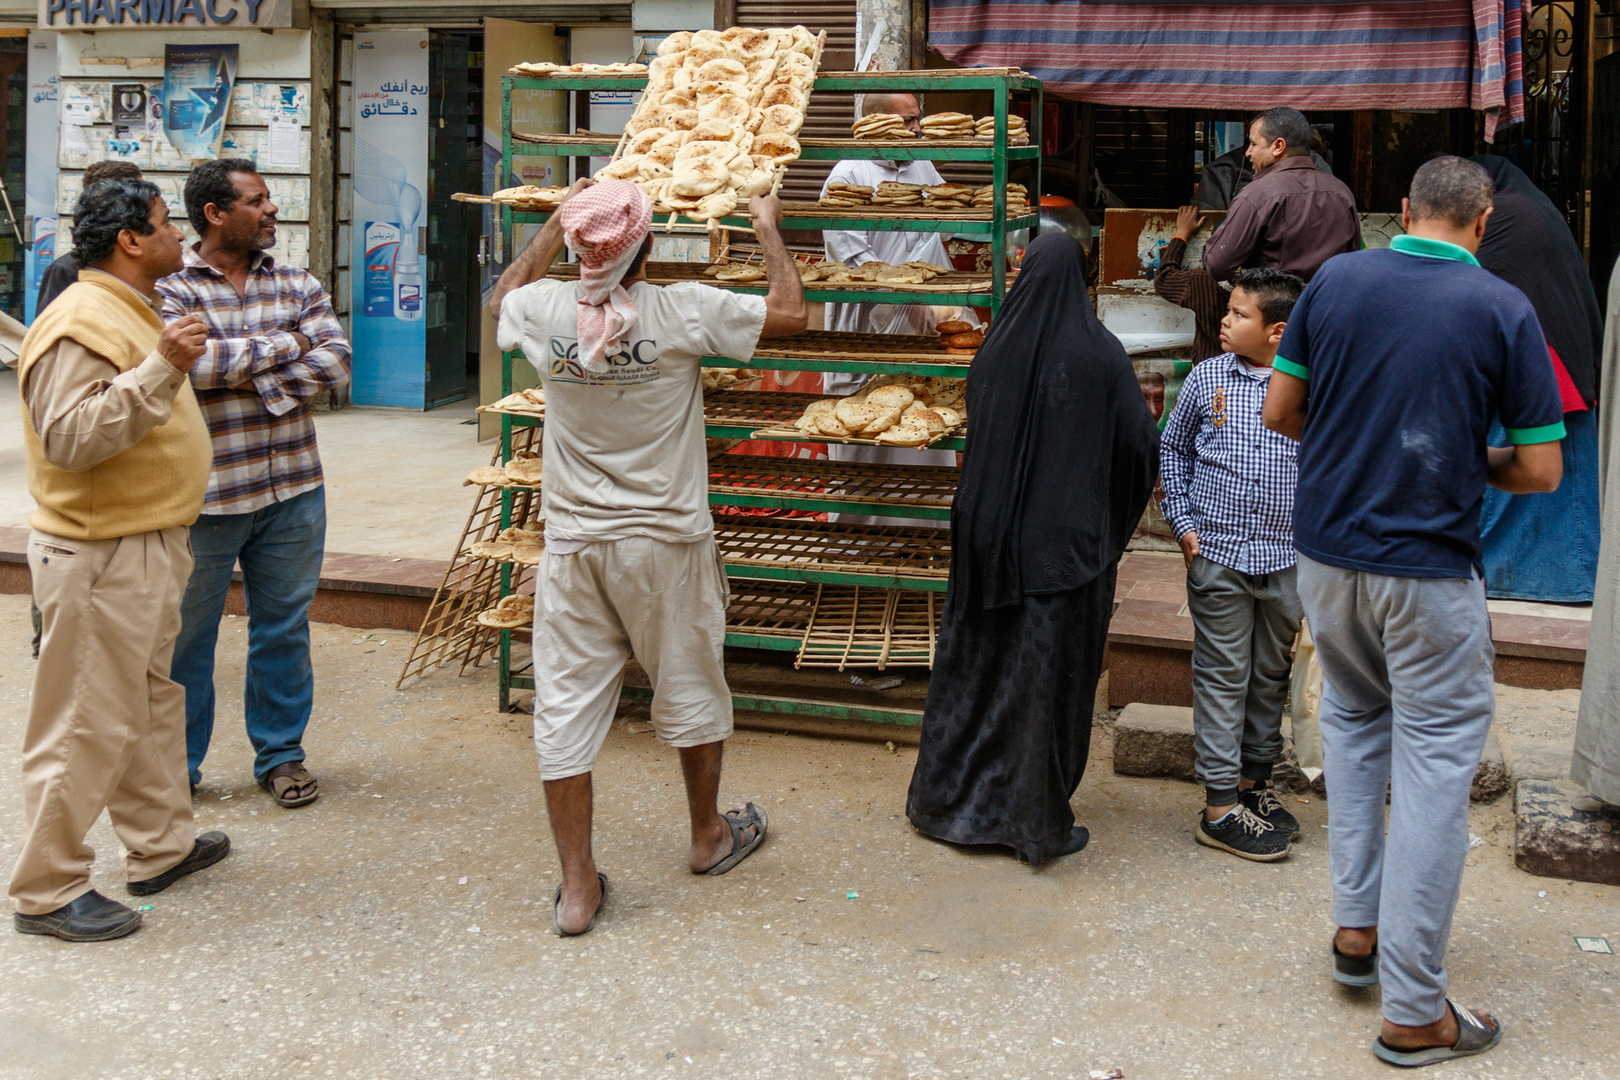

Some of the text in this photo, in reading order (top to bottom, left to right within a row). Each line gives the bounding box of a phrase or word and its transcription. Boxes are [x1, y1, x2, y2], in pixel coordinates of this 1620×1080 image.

[46, 0, 263, 25] PHARMACY
[410, 84, 428, 95] ريح
[383, 98, 401, 108] خلال
[361, 102, 418, 119] دقائق
[605, 339, 659, 366] SC
[621, 366, 643, 374] Saudi
